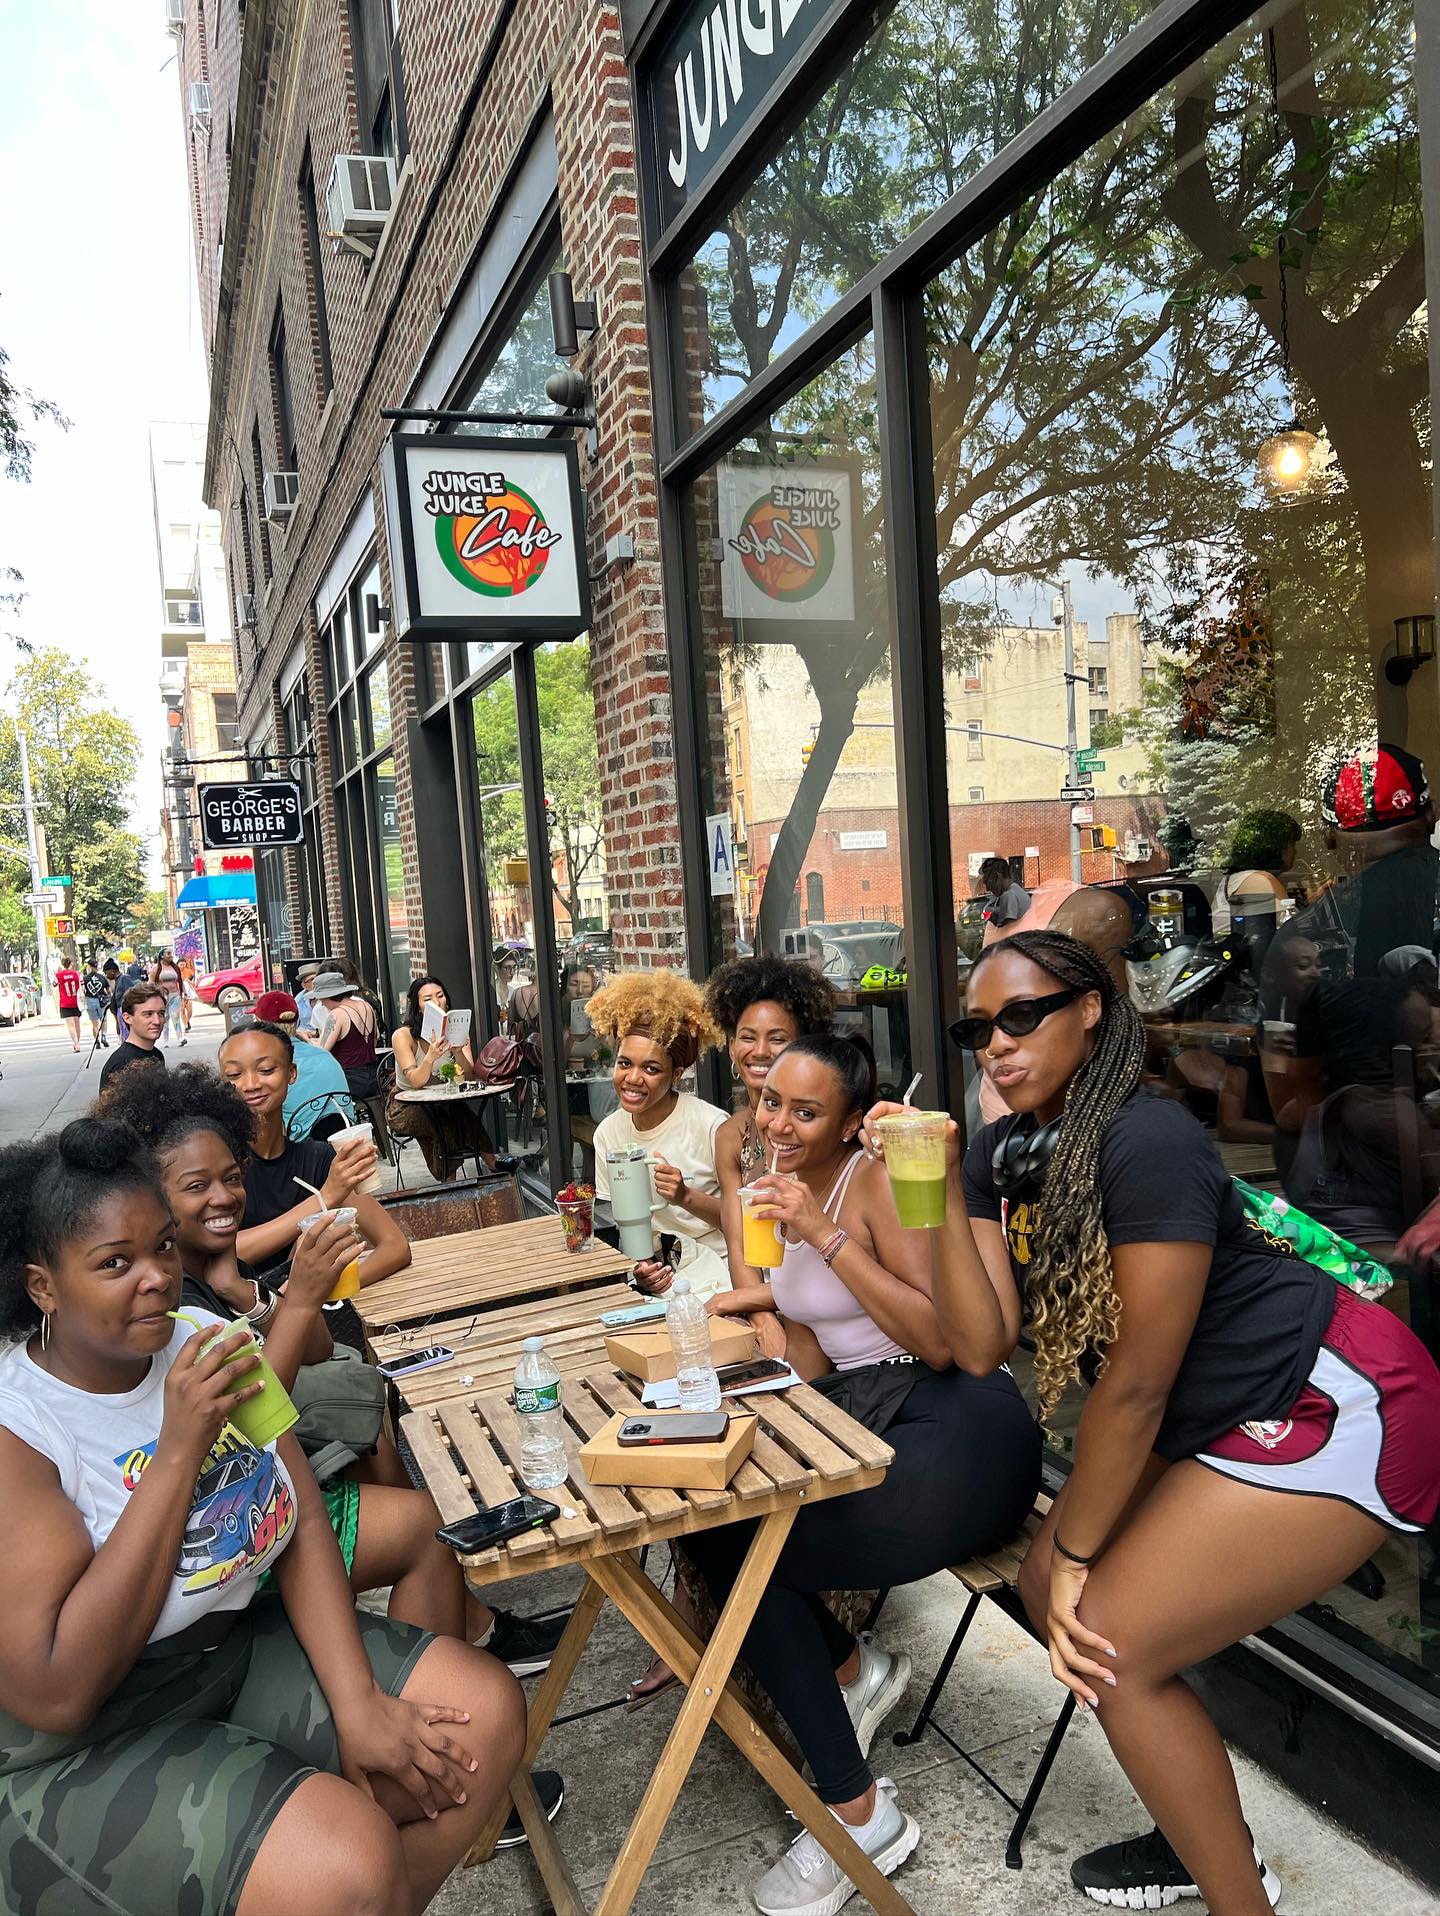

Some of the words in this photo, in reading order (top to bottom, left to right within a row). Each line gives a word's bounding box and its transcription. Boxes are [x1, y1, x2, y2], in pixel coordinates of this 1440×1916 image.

[422, 471, 506, 496] JUNGLE
[424, 494, 487, 516] JUICE
[461, 508, 562, 560] Cafe
[206, 798, 297, 817] GEORGE'S
[221, 816, 286, 833] BARBER
[242, 833, 268, 842] SHOP
[713, 824, 730, 873] A
